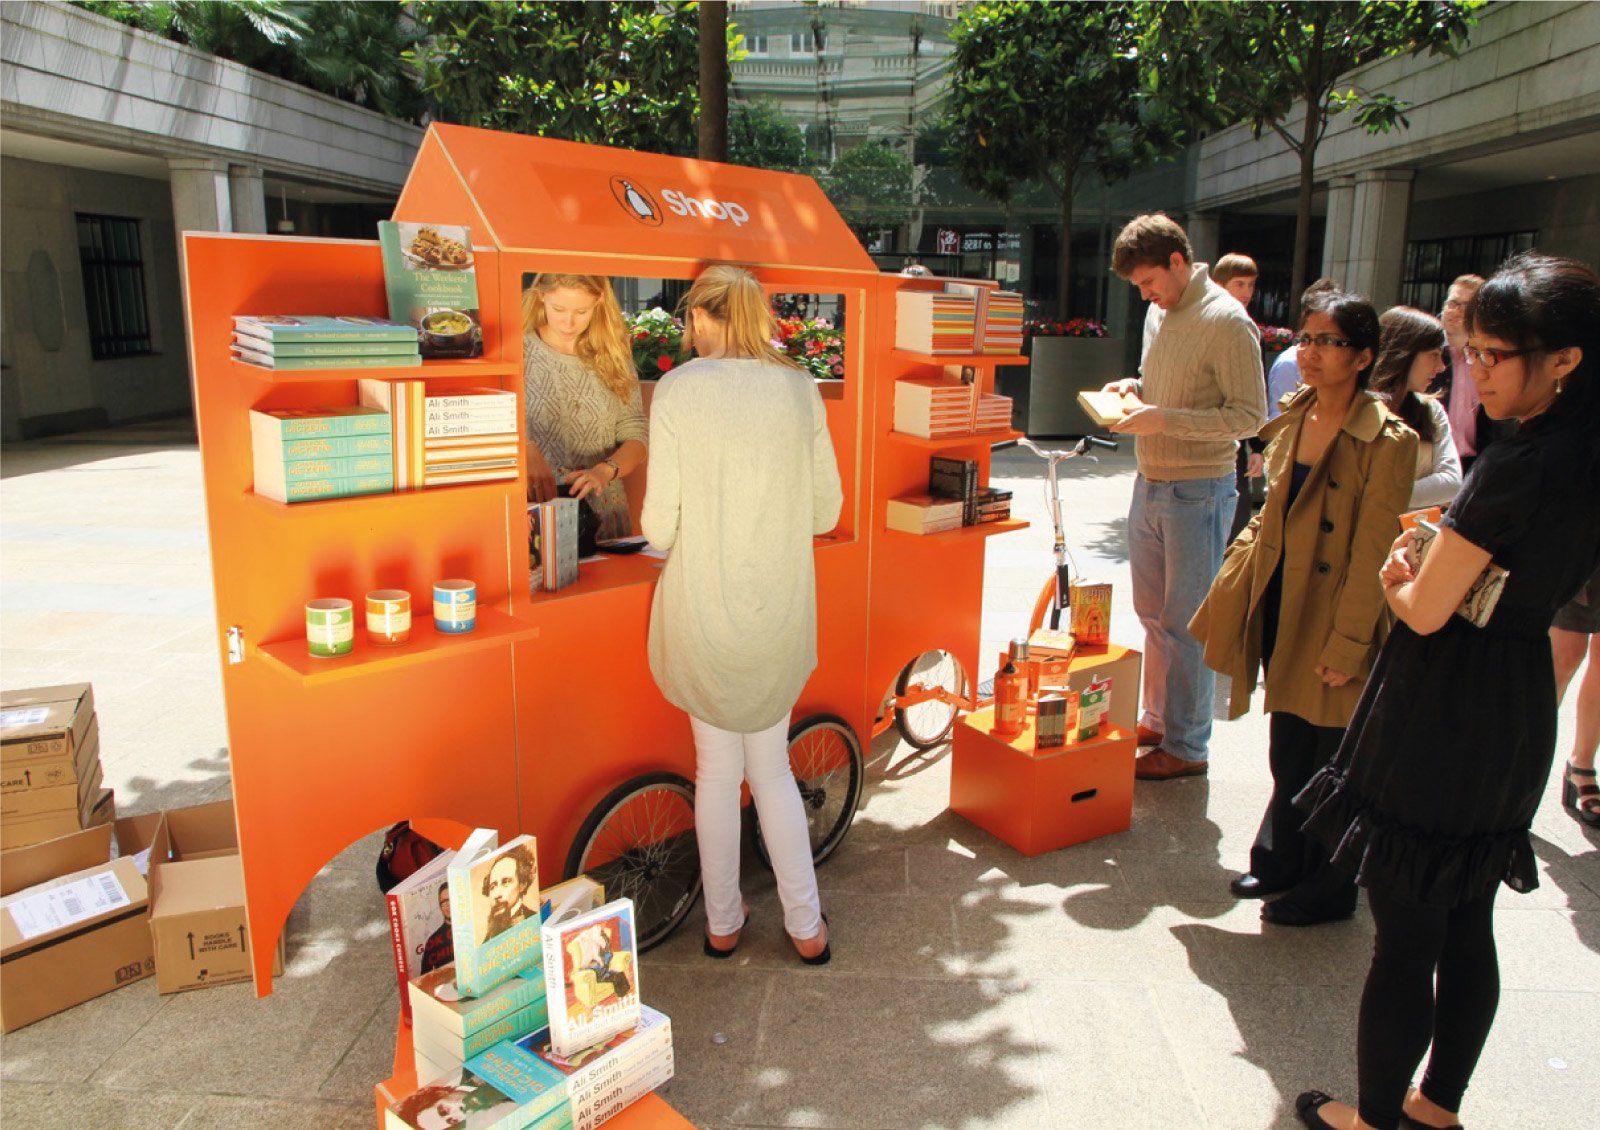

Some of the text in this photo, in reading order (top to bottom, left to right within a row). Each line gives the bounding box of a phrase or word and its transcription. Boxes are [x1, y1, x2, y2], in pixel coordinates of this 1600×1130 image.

[661, 189, 750, 227] Shop
[414, 271, 467, 284] The Weekend
[420, 282, 464, 294] Cookbook
[428, 399, 440, 408] Ali
[442, 397, 470, 407] Smith
[428, 412, 440, 421] Ali
[442, 411, 470, 420] Smith
[428, 426, 440, 435] Ali
[442, 425, 470, 434] Smith
[1, 779, 23, 787] CARE
[203, 937, 231, 946] HANDLE
[204, 932, 230, 940] BOOKS
[199, 942, 238, 953] WITH CARE
[479, 934, 541, 975] DICKENS
[544, 934, 557, 989] Ali Smith
[567, 993, 637, 1034] Ali Smith
[484, 1050, 546, 1092] DICKENS
[573, 1076, 586, 1091] Ali
[588, 1057, 619, 1080] Smith
[578, 1091, 591, 1105] Ali
[593, 1070, 622, 1094] Smith
[578, 1107, 591, 1122] Ali
[593, 1087, 623, 1112] Smith
[580, 1121, 592, 1130] Ali
[593, 1101, 623, 1126] Smith
